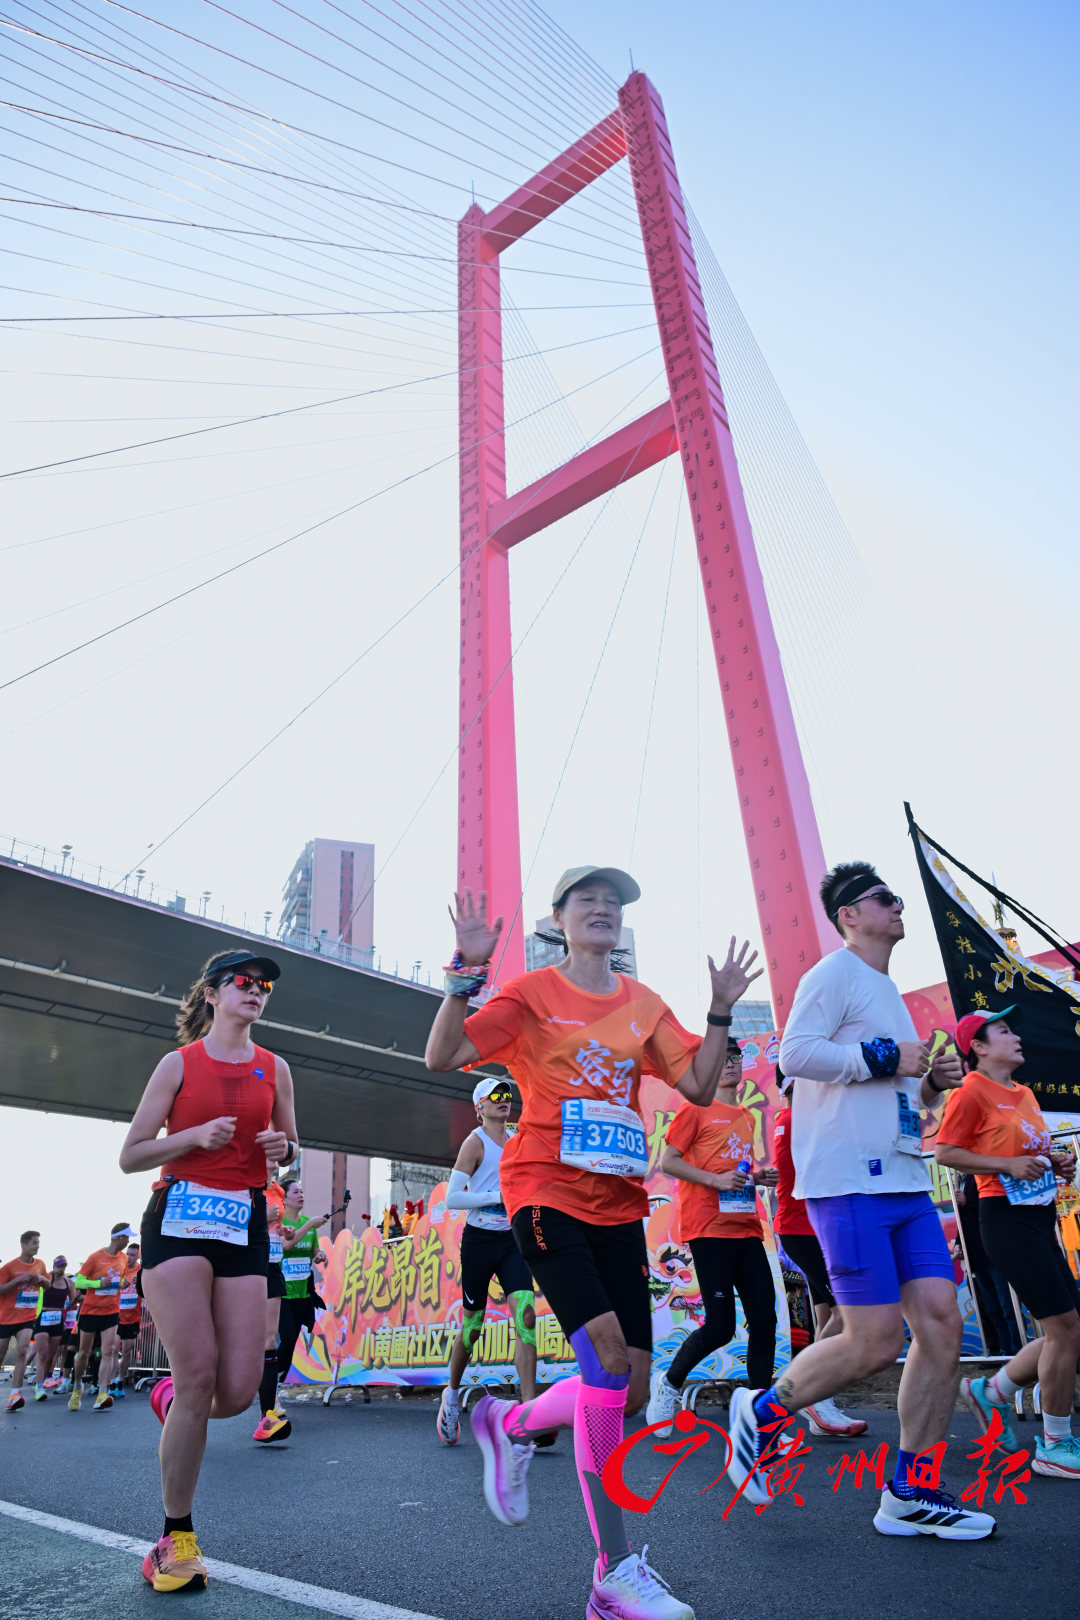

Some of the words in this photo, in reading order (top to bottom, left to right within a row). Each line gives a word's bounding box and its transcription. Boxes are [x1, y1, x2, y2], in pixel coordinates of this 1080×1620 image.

[566, 1100, 580, 1119] E
[899, 1093, 909, 1109] E
[587, 1124, 645, 1155] 37503
[171, 1181, 186, 1195] D
[186, 1197, 249, 1224] 34620
[289, 1264, 310, 1273] 34302
